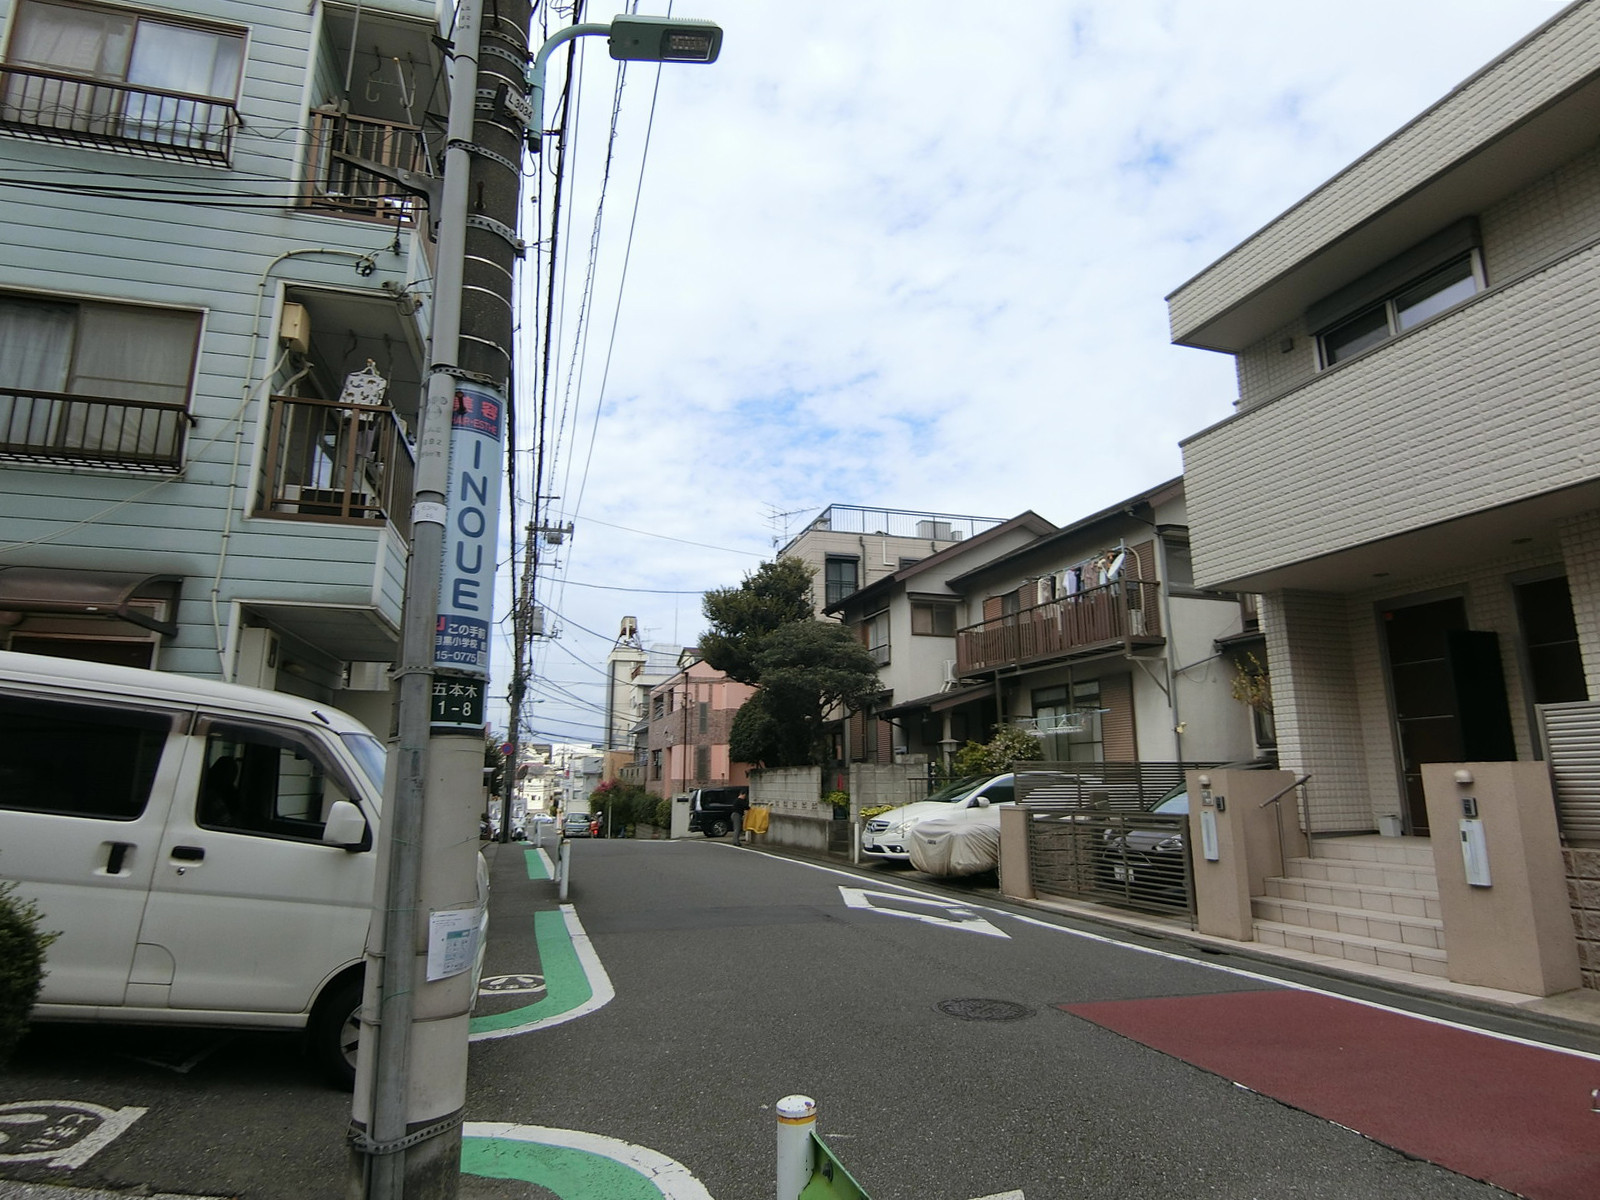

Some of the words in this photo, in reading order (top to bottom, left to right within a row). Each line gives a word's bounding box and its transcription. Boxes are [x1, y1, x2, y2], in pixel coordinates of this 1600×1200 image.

[452, 440, 488, 612] INOUE
[448, 623, 487, 640] この手前
[432, 682, 478, 698] 五本木
[438, 700, 472, 717] 1-8
